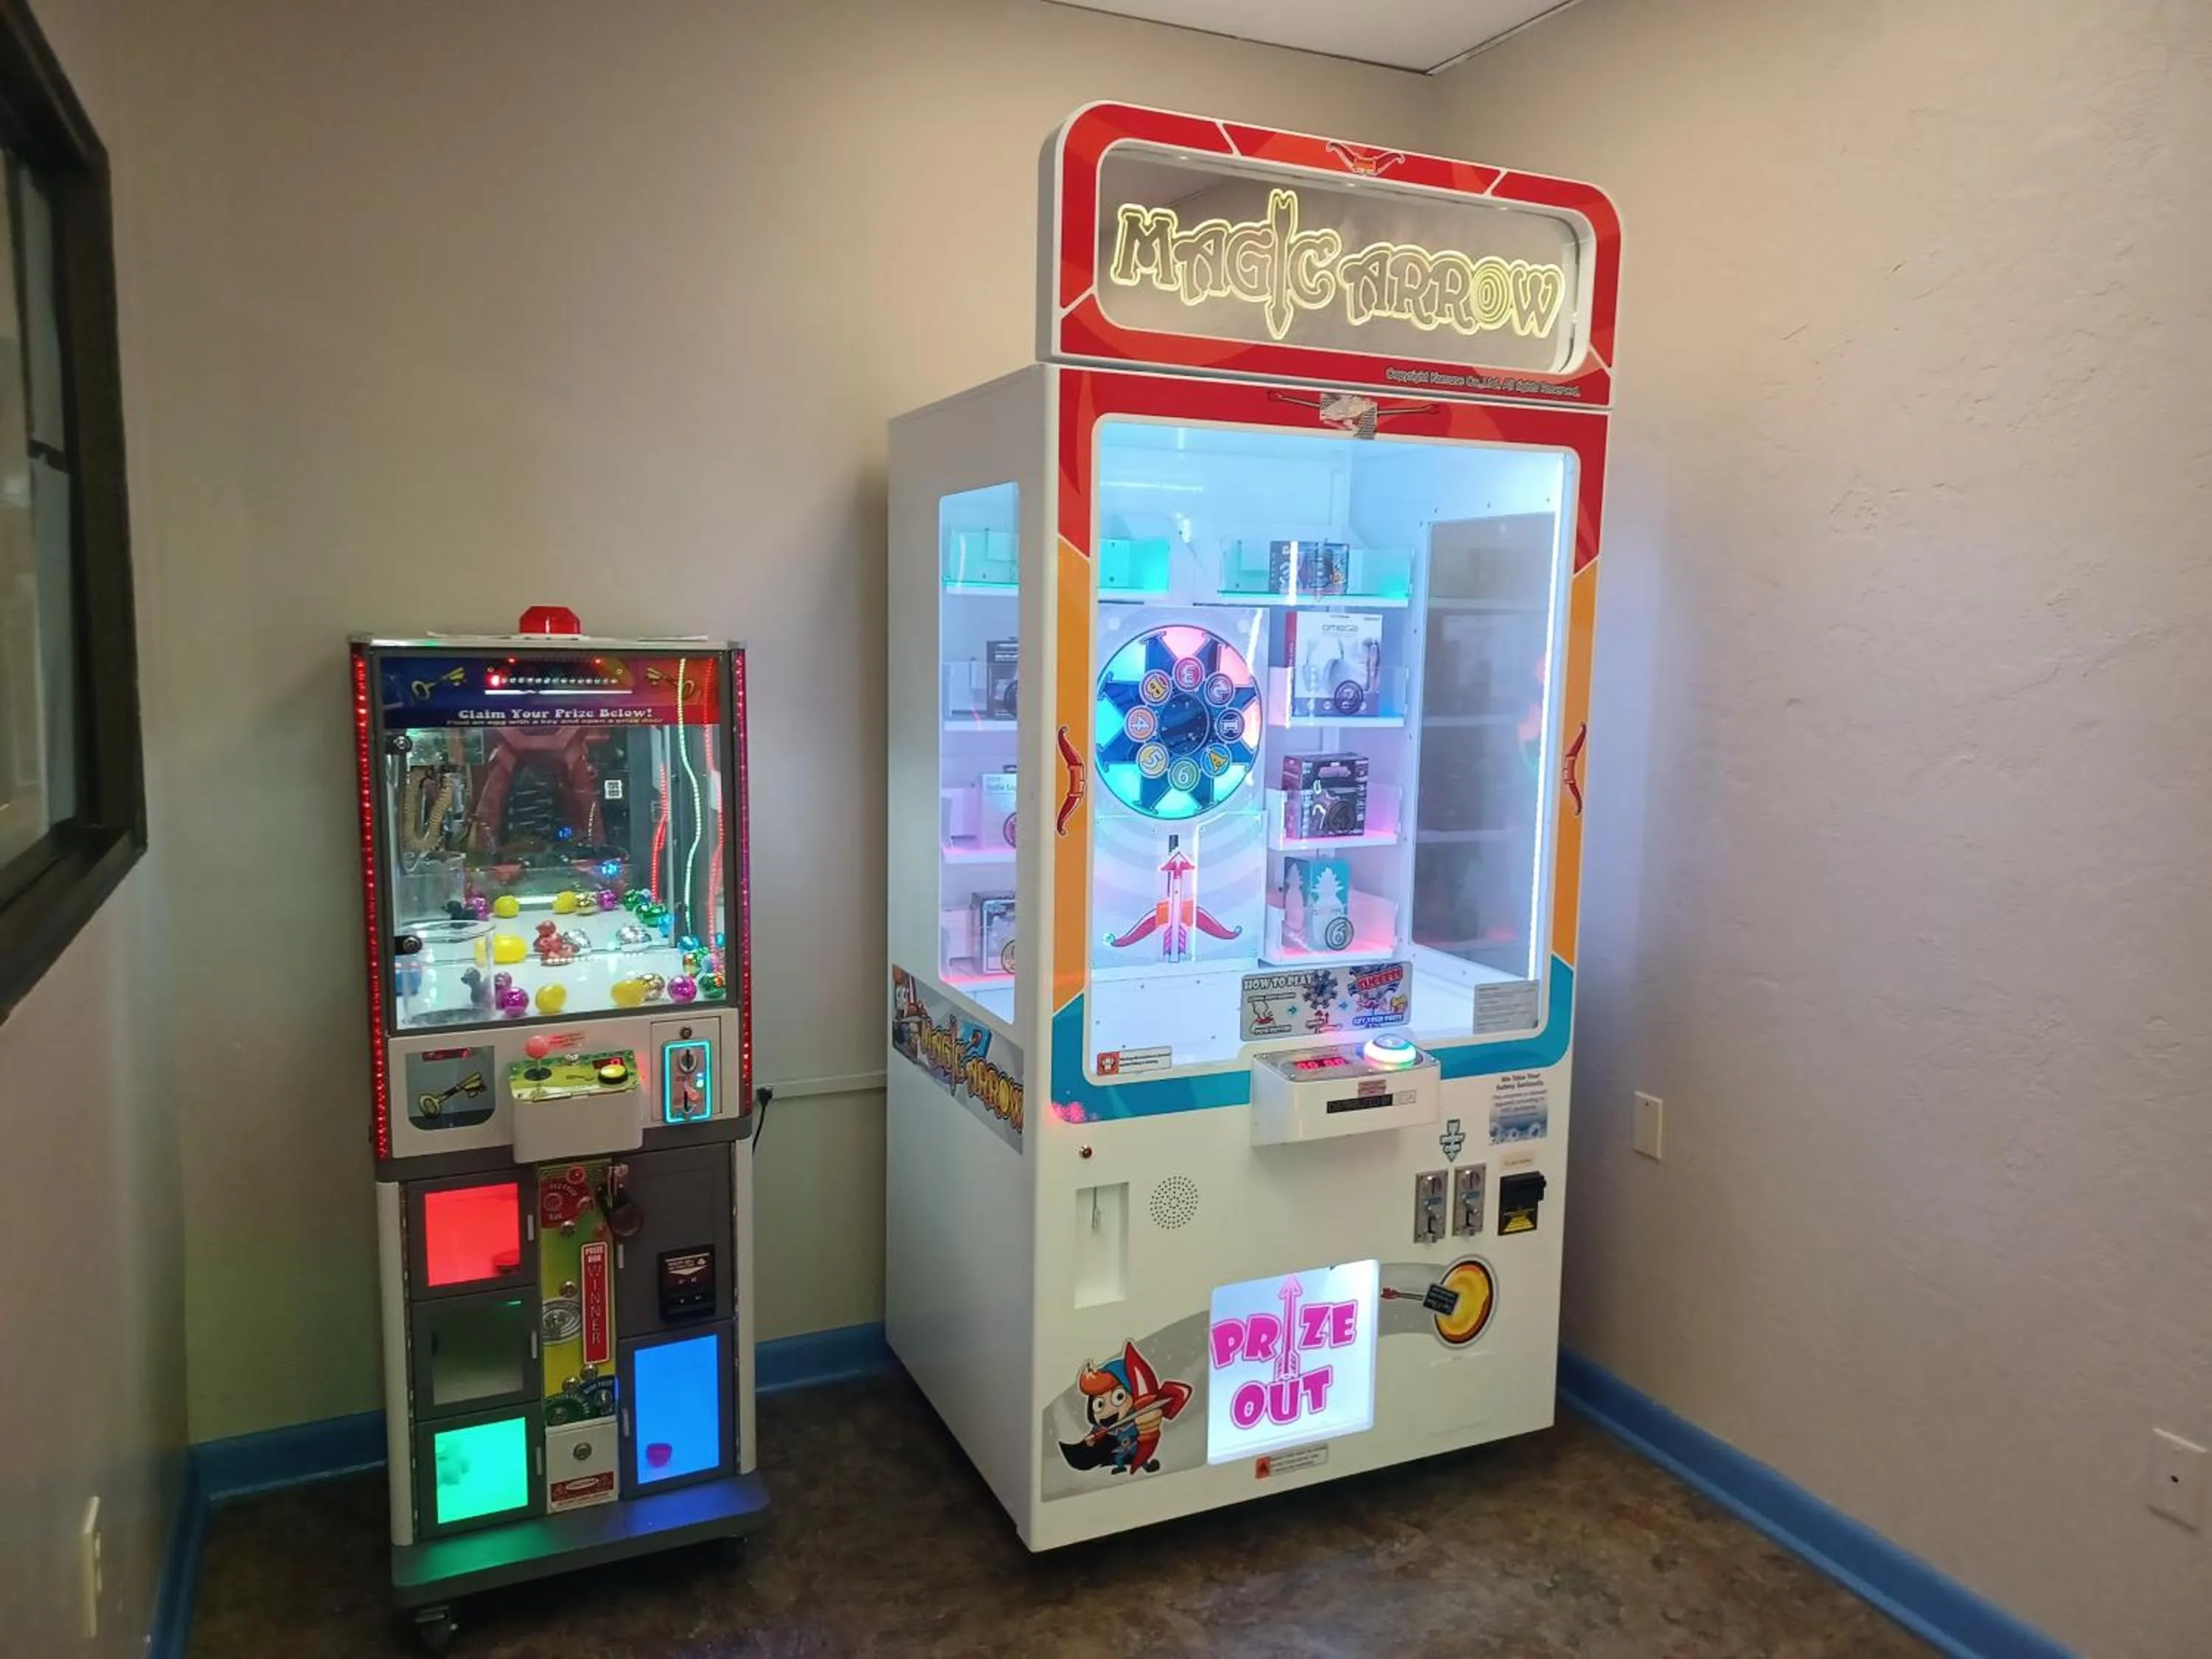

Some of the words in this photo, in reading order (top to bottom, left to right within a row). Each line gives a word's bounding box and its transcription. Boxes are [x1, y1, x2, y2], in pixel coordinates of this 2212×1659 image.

[1112, 189, 1342, 340] MAGIC
[1340, 243, 1566, 338] ARROW
[458, 709, 507, 719] Claim
[511, 709, 551, 719] Your
[554, 708, 594, 718] Prize
[599, 707, 653, 717] Below!
[1332, 922, 1346, 945] 6
[1243, 978, 1270, 990] HOW
[1271, 976, 1286, 989] TO
[1287, 973, 1312, 987] PLAY
[587, 1264, 602, 1346] WINNER
[1211, 1273, 1358, 1382] PRIZE
[1231, 1366, 1334, 1430] OUT
